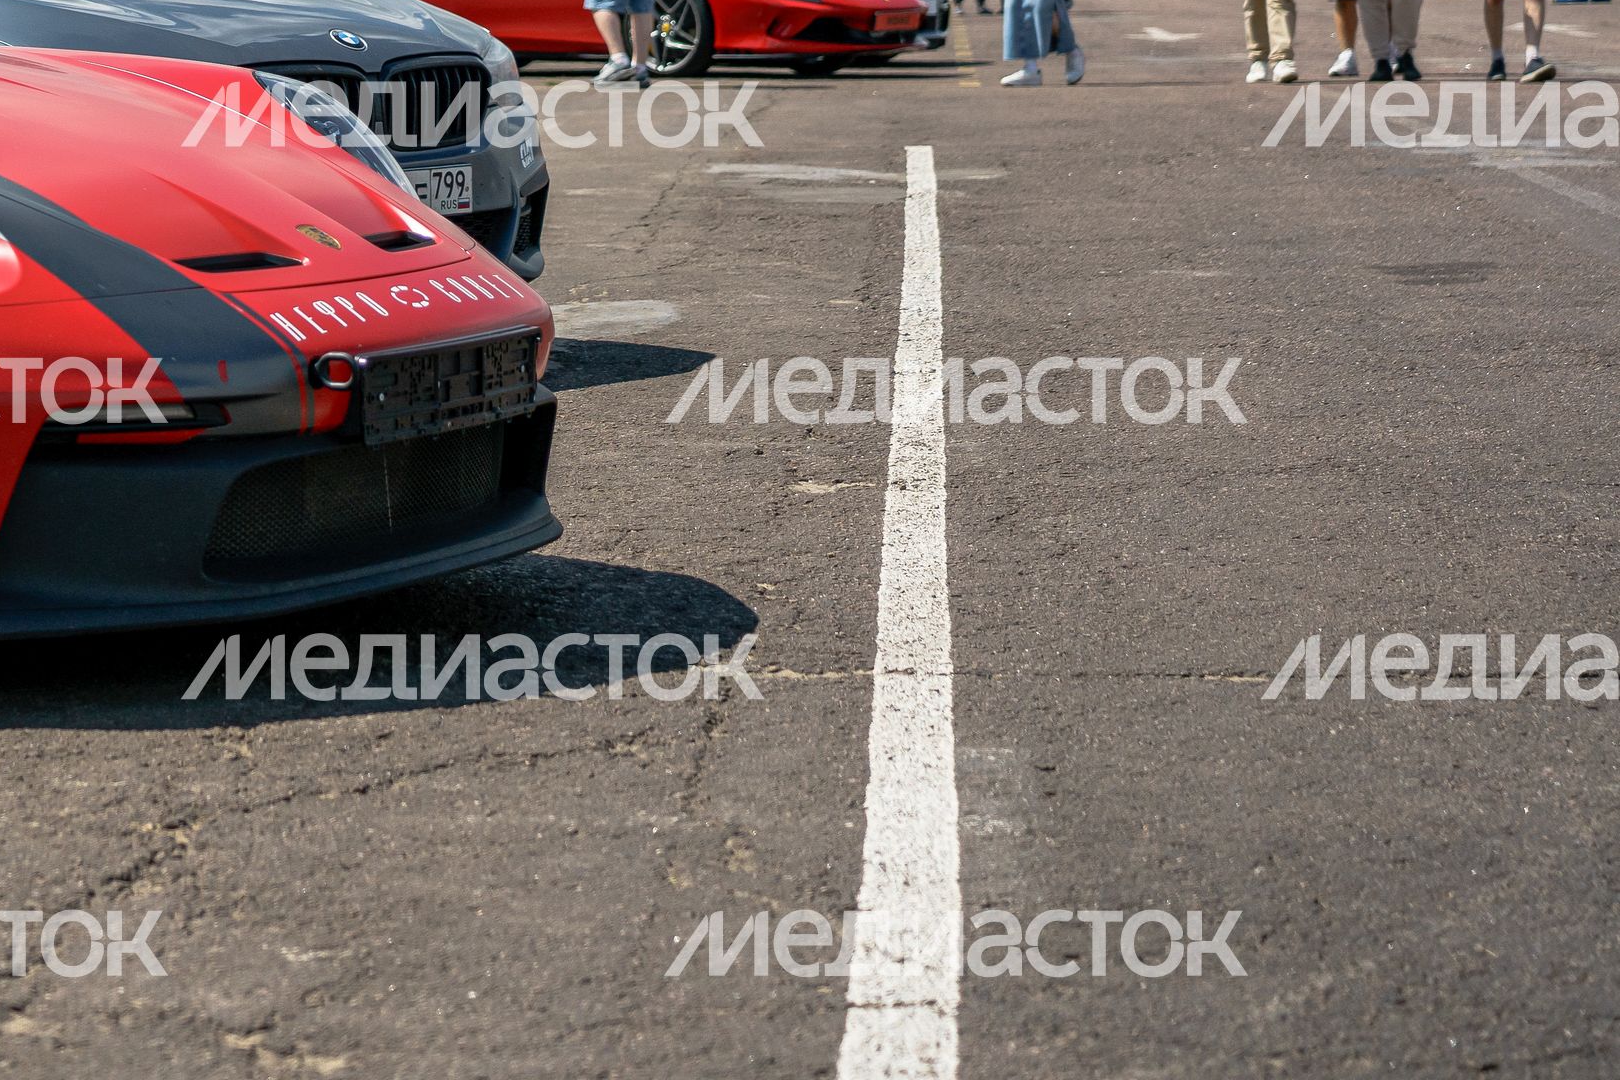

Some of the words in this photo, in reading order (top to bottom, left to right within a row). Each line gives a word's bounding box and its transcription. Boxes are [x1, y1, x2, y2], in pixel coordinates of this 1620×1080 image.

[433, 170, 466, 199] 799
[441, 200, 457, 210] RUS
[270, 291, 388, 341] НЕФРО
[429, 274, 524, 303] СОВЕТ
